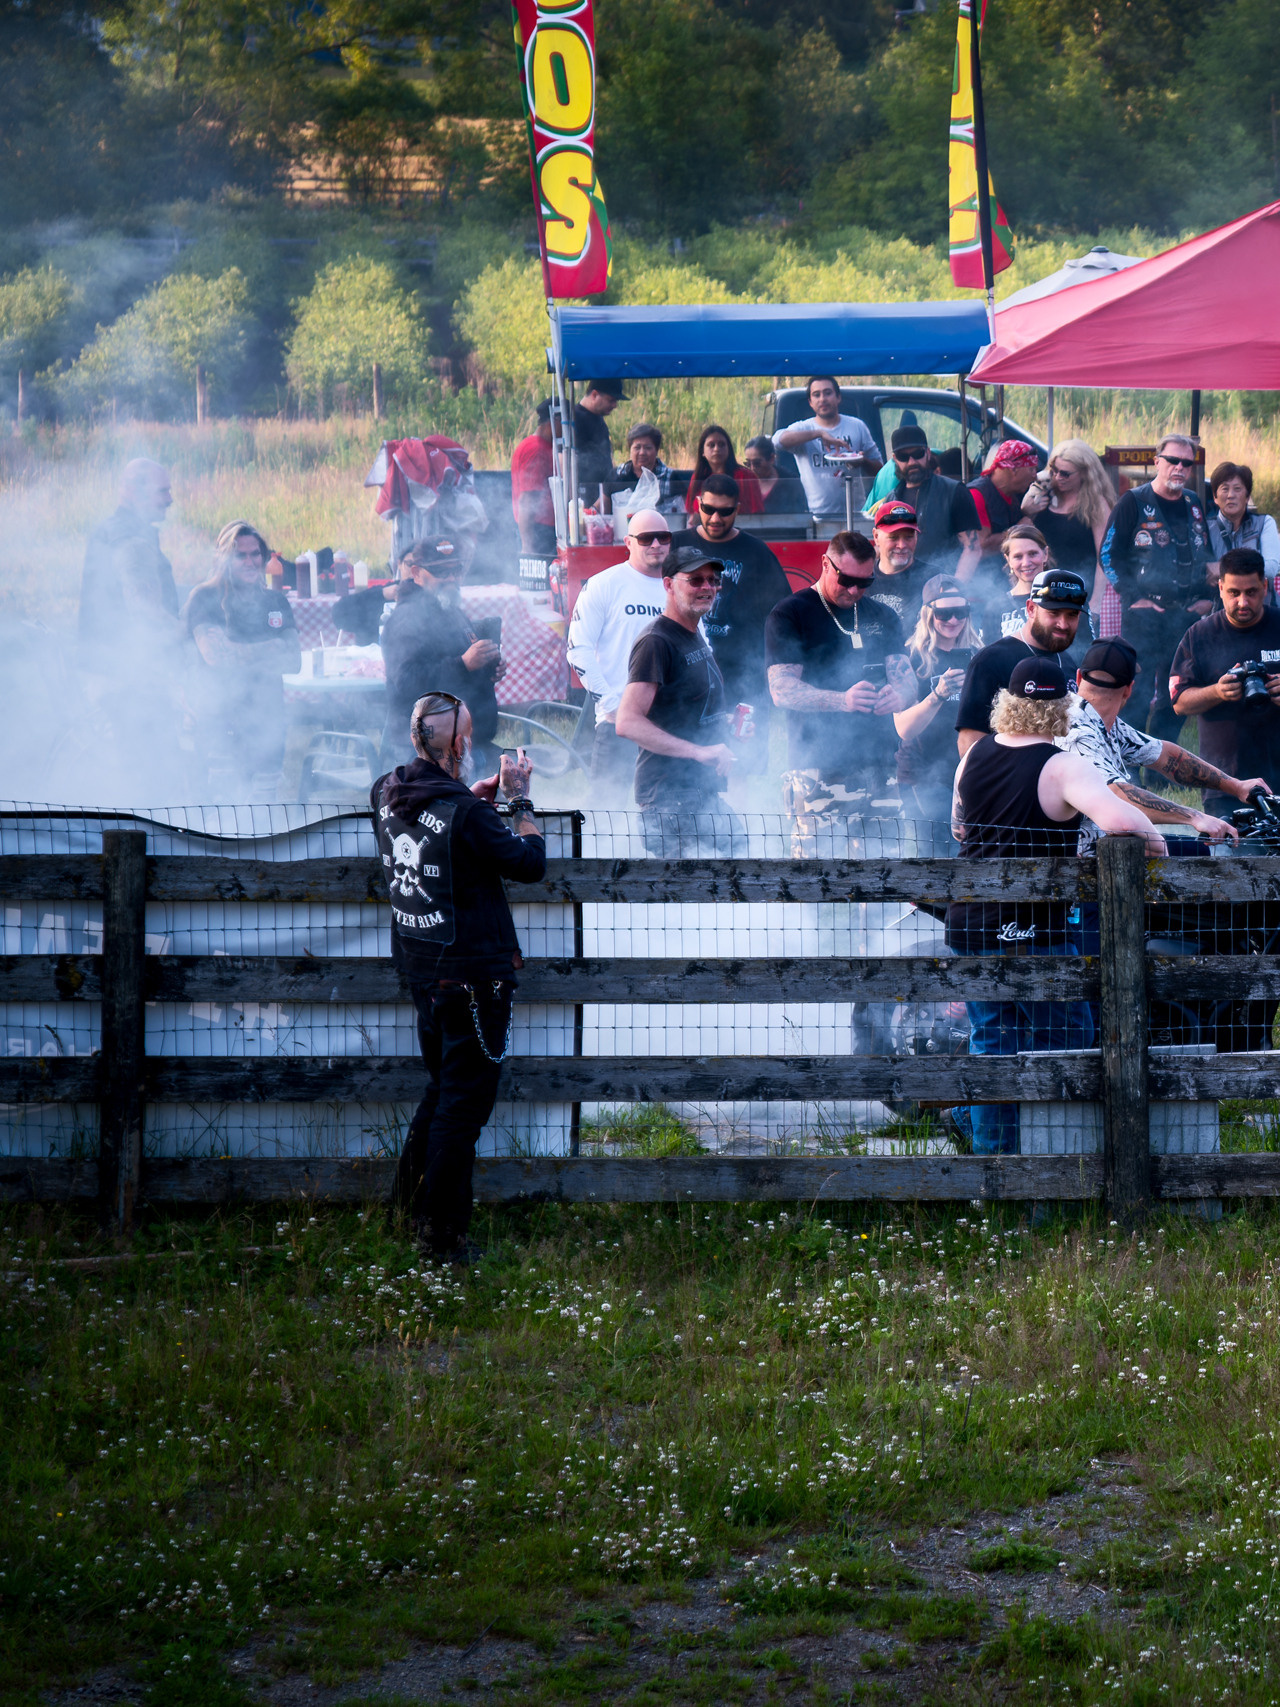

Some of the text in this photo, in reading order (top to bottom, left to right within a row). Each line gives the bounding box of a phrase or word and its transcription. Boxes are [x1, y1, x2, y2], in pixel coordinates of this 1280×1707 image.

[525, 0, 596, 266] OS
[625, 604, 664, 617] ODIN
[417, 910, 445, 928] RIM
